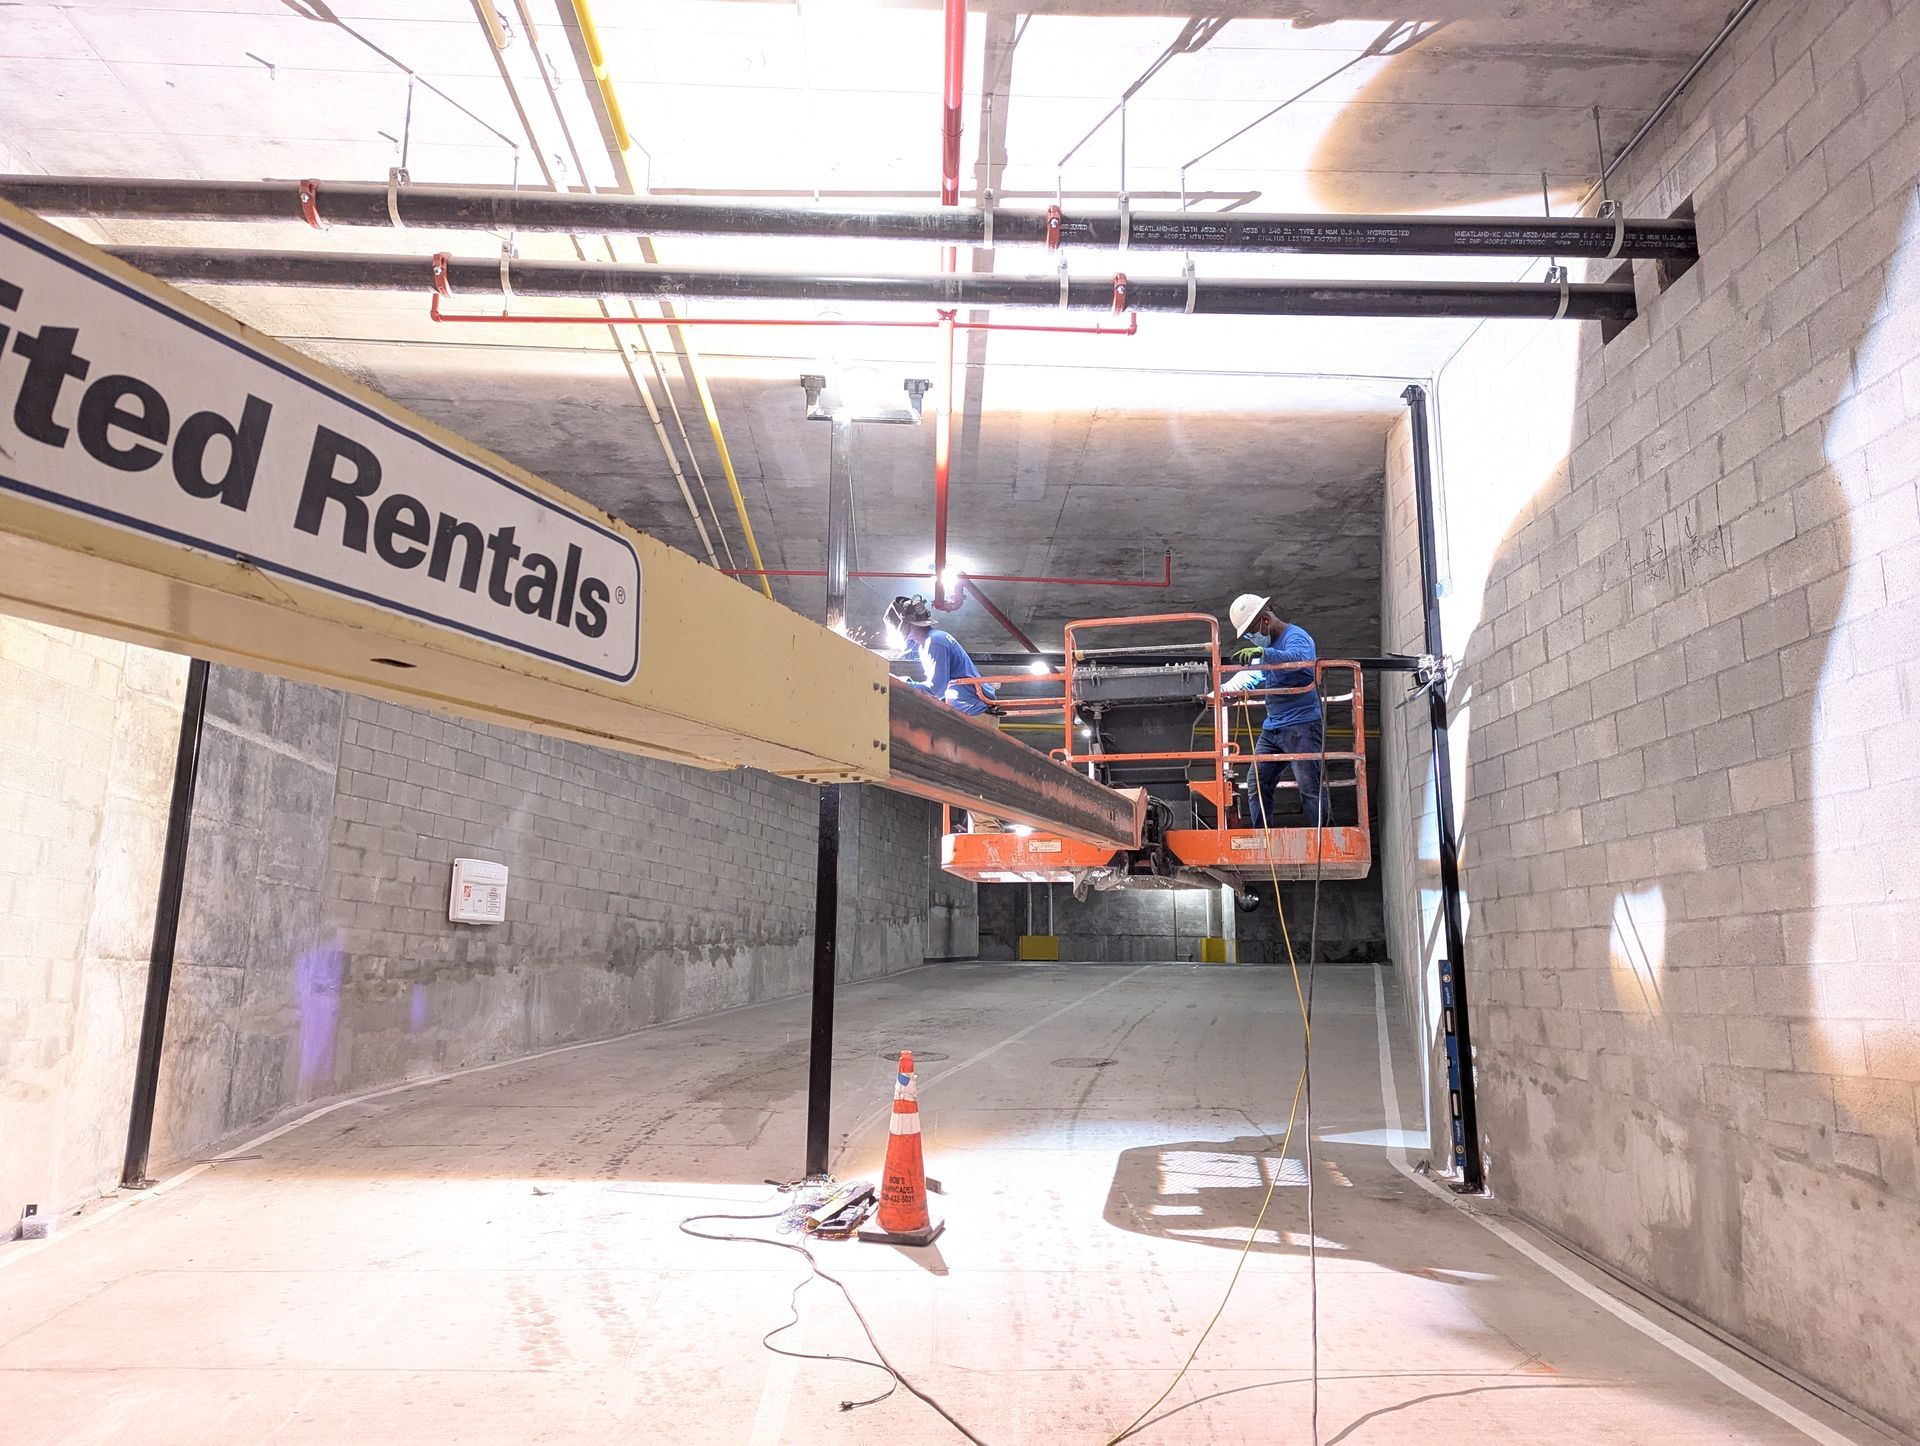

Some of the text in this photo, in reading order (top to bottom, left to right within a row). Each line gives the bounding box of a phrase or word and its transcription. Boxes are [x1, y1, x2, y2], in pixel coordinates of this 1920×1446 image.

[1367, 229, 1410, 237] HYDROTESTED
[293, 424, 611, 639] Rentals
[889, 1176, 905, 1184] BOB'S
